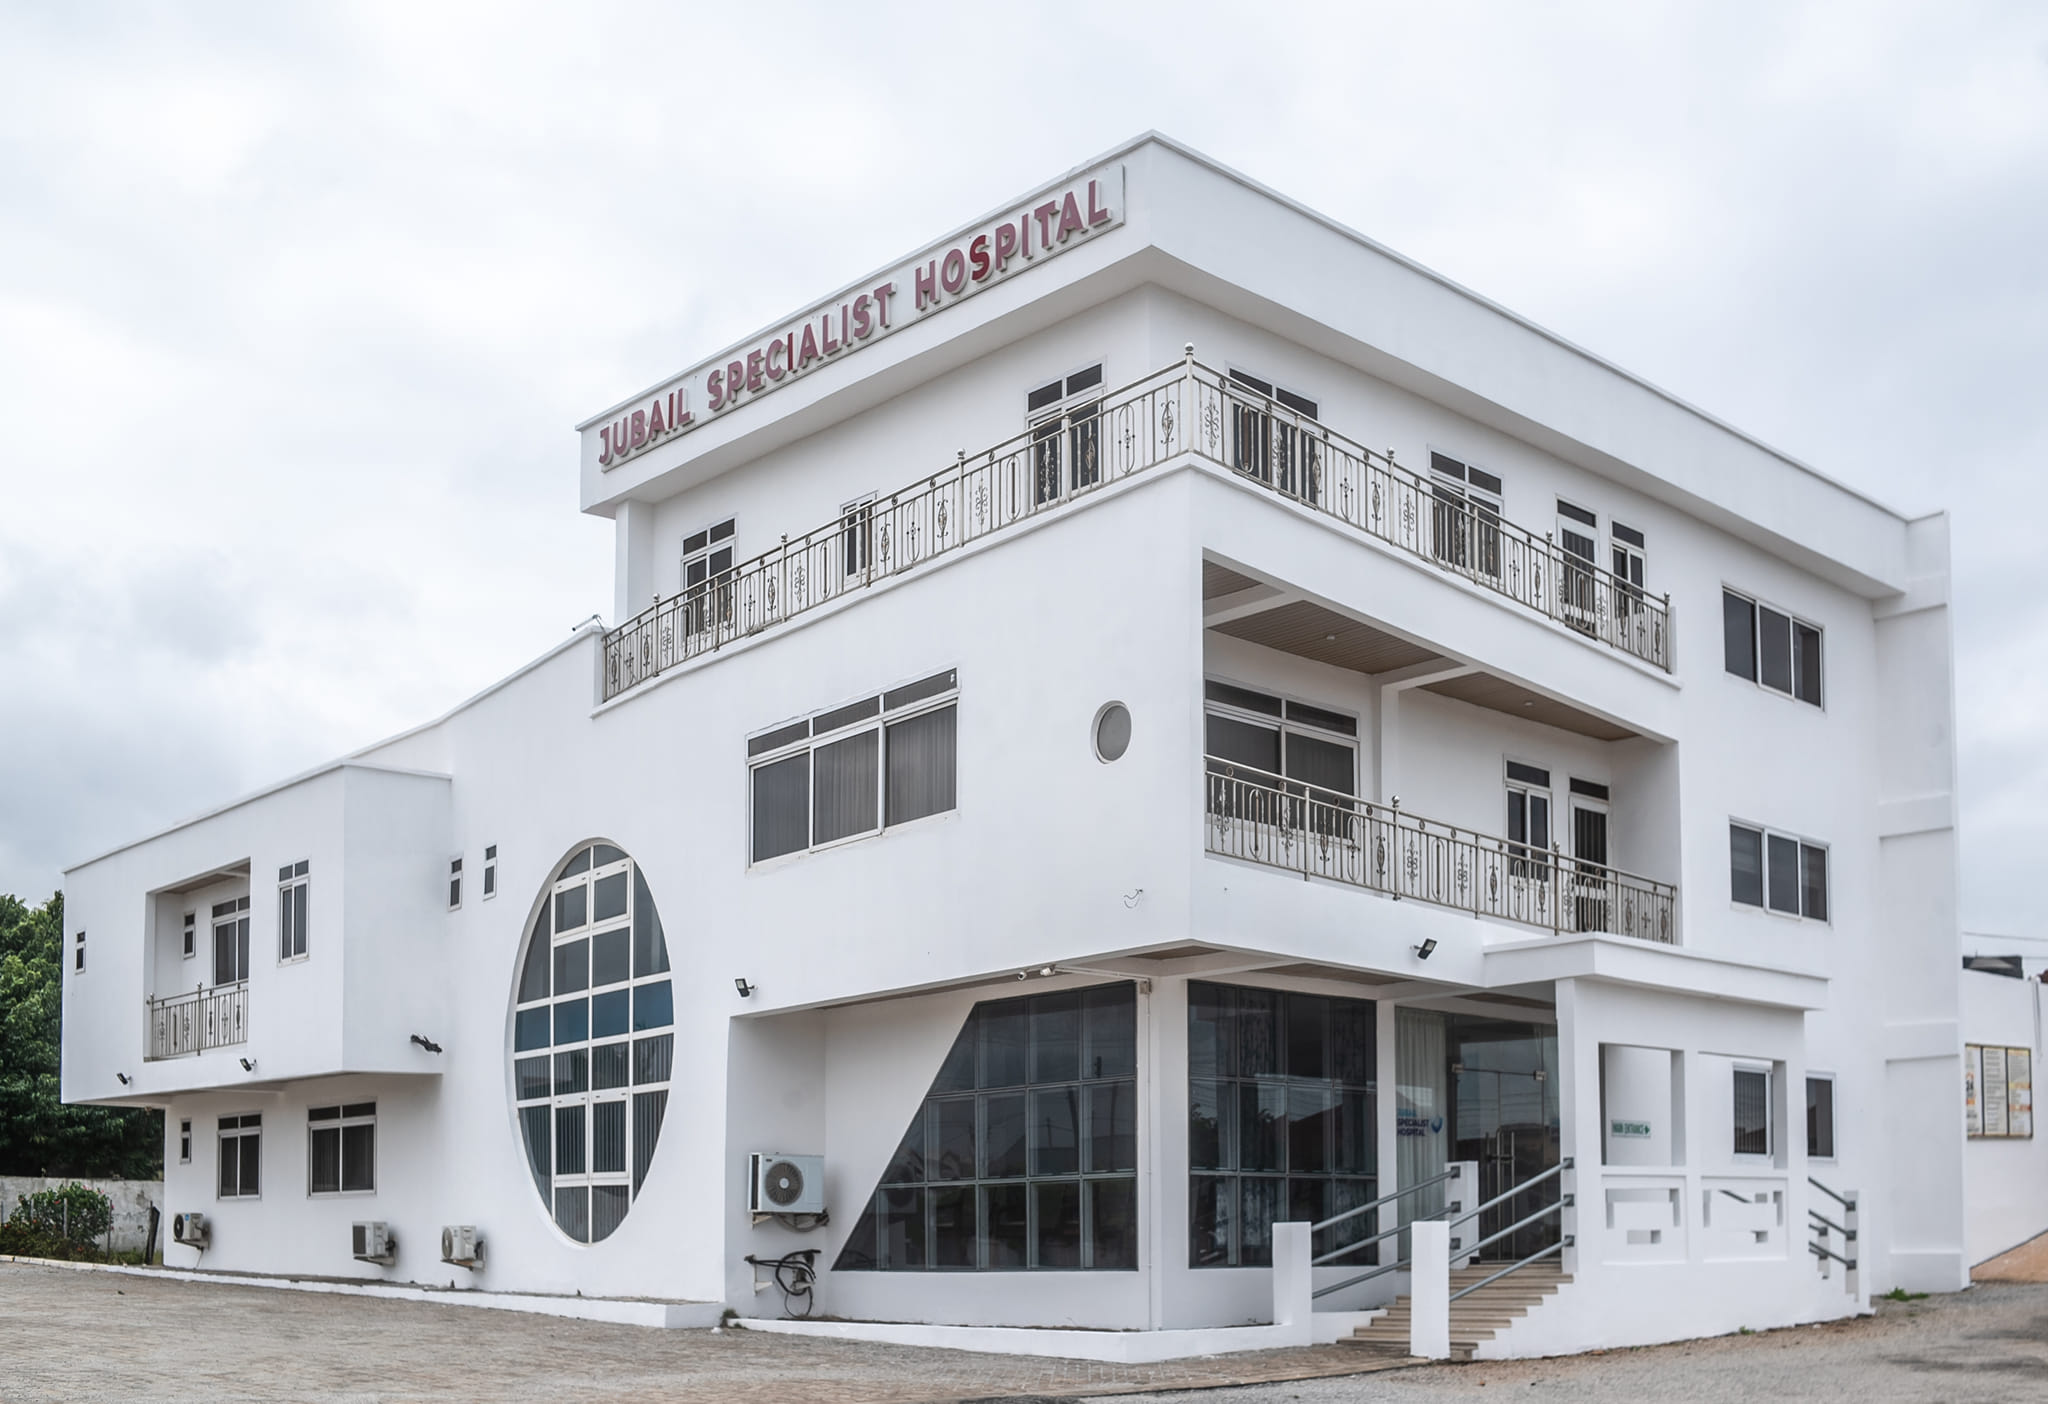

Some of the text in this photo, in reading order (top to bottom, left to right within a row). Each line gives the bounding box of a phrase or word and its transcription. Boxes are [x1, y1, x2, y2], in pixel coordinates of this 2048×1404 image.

[599, 180, 1110, 465] JUBAIL SPECIALIST HOSPITAL
